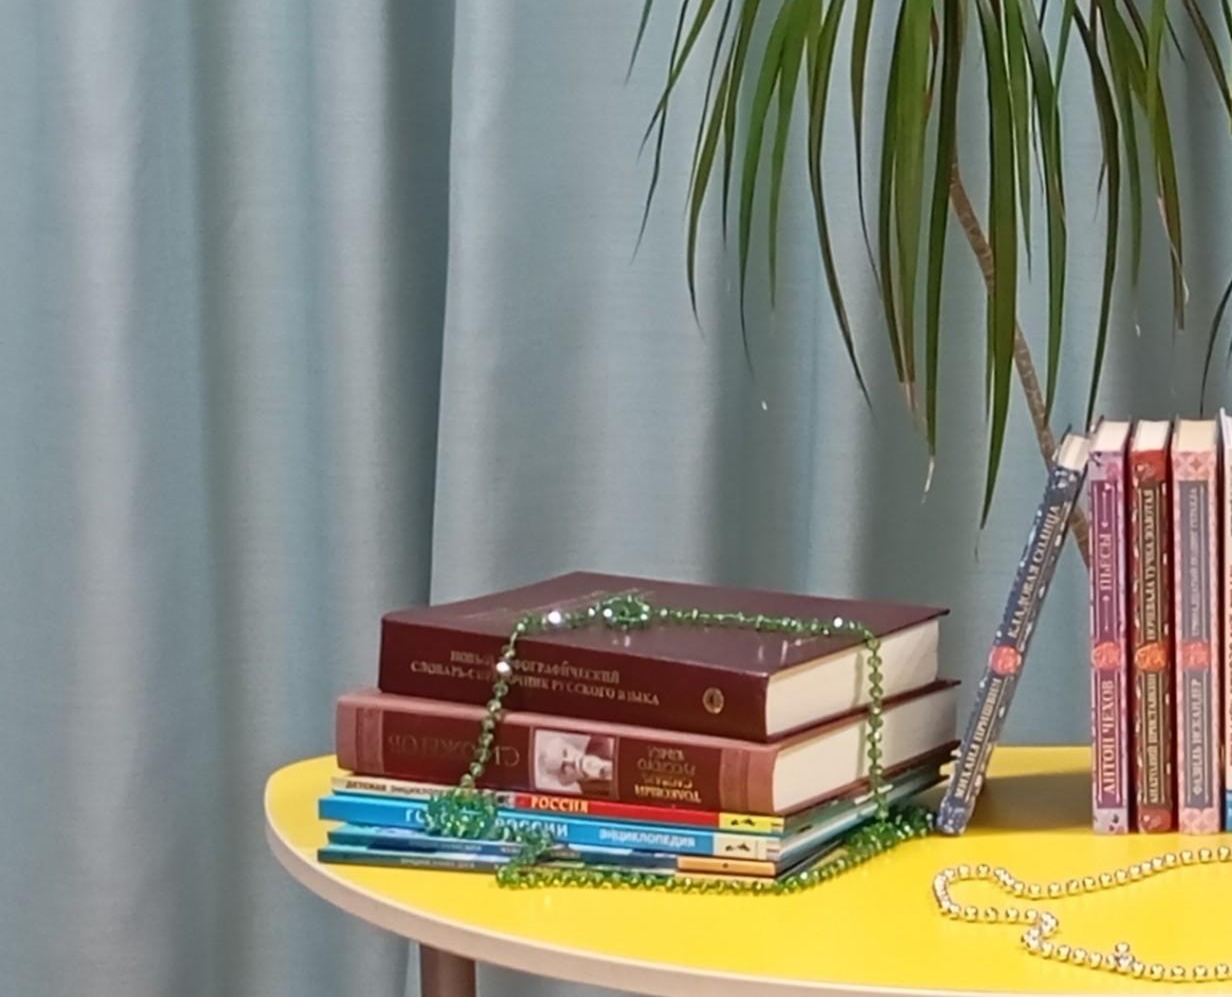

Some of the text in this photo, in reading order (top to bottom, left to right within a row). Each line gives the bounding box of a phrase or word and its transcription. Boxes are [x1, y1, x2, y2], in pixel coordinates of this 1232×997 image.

[1007, 505, 1061, 639] КЛАДОВАЯ СОЛНЦА
[1099, 533, 1113, 591] ПЬЕСЫ
[1143, 489, 1156, 640] НОЧЕВАЛА ТУЧКА ЗОЛОТАЯ
[552, 679, 616, 699] РУССКОГО
[954, 677, 1002, 798] МИХАИЛ ПРИШВИН
[1101, 679, 1116, 795] АНТОН ЧЕХОВ
[1146, 673, 1159, 804] АНАТОЛИЙ ПРИСТАВКИН
[1191, 678, 1203, 795] ФАЗИЛЬ ИСКАНДЕР
[531, 795, 589, 813] РОССИЯ
